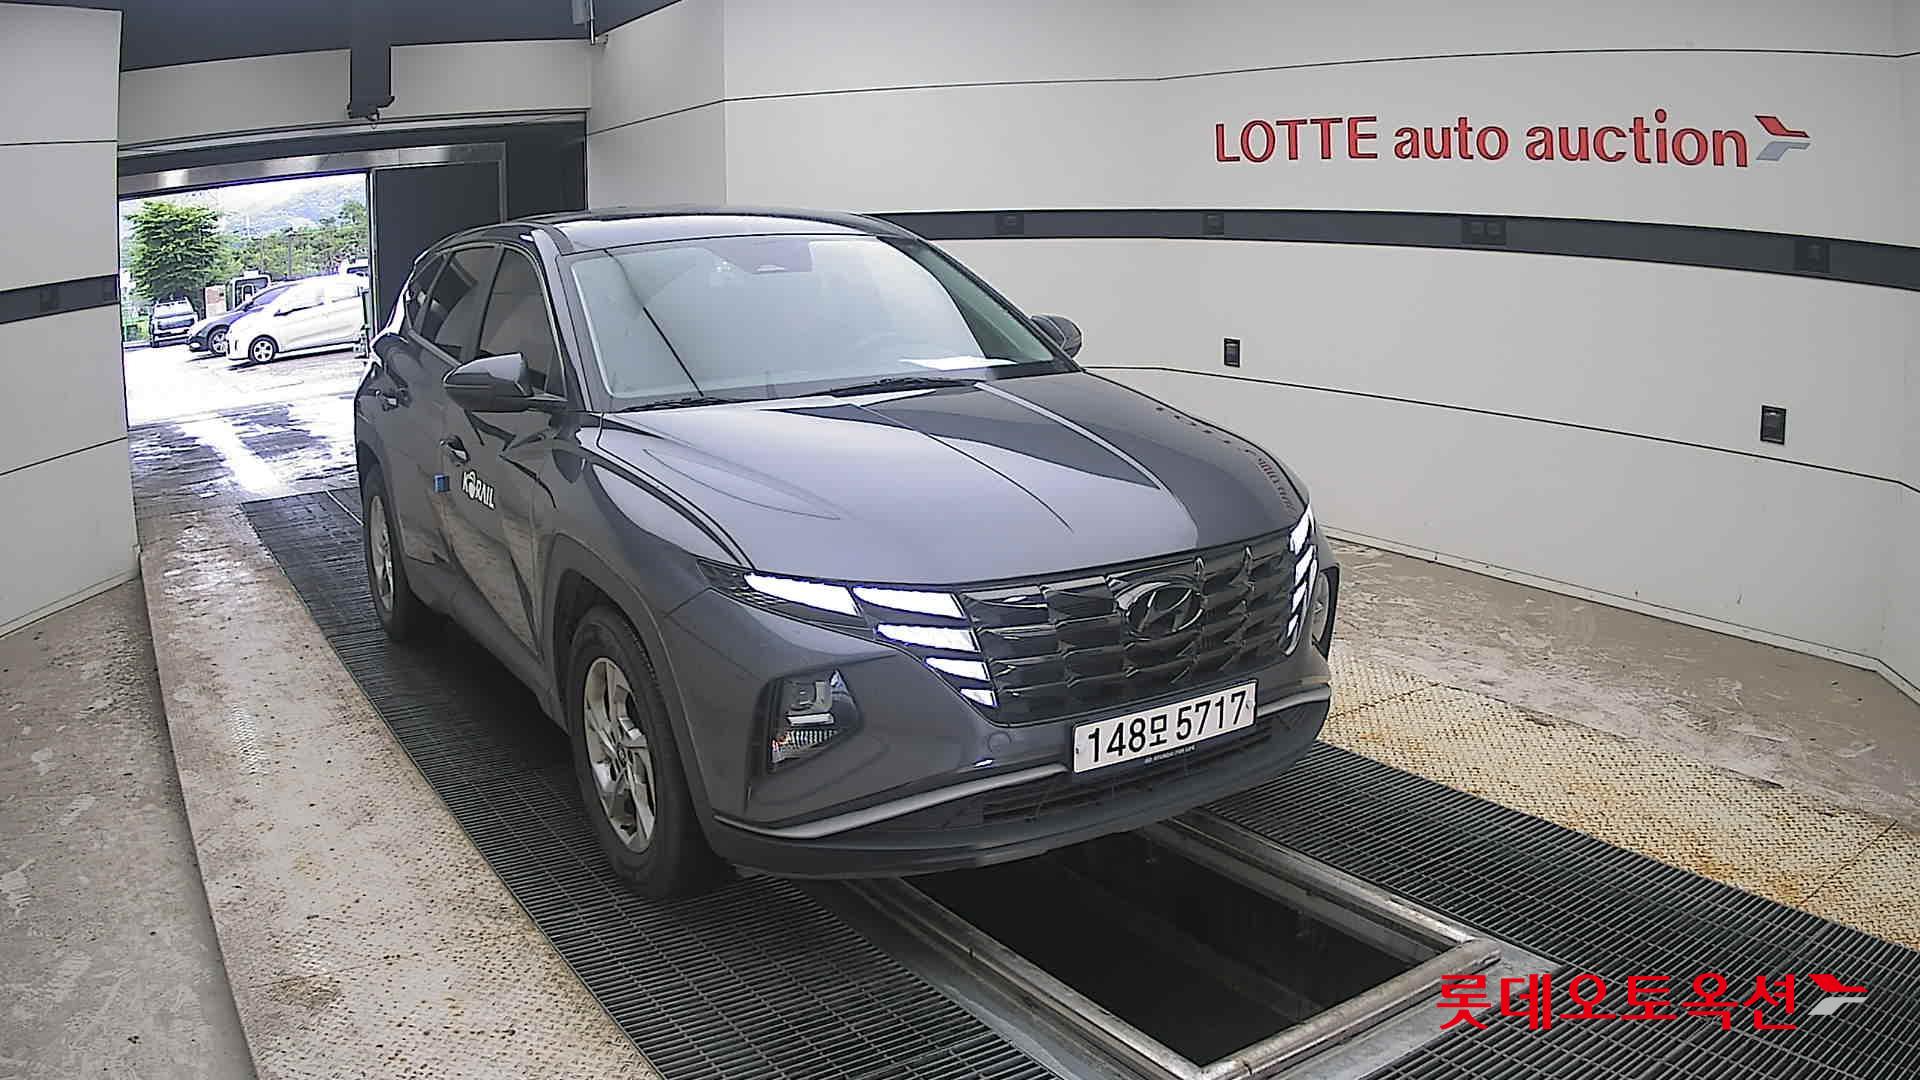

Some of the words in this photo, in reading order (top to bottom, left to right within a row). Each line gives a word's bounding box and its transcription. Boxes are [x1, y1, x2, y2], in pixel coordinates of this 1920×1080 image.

[1215, 116, 1378, 162] LOTTE
[1394, 117, 1509, 161] auto
[1526, 109, 1748, 168] auction
[462, 471, 495, 509] KORAIL
[1176, 690, 1247, 740] 5717
